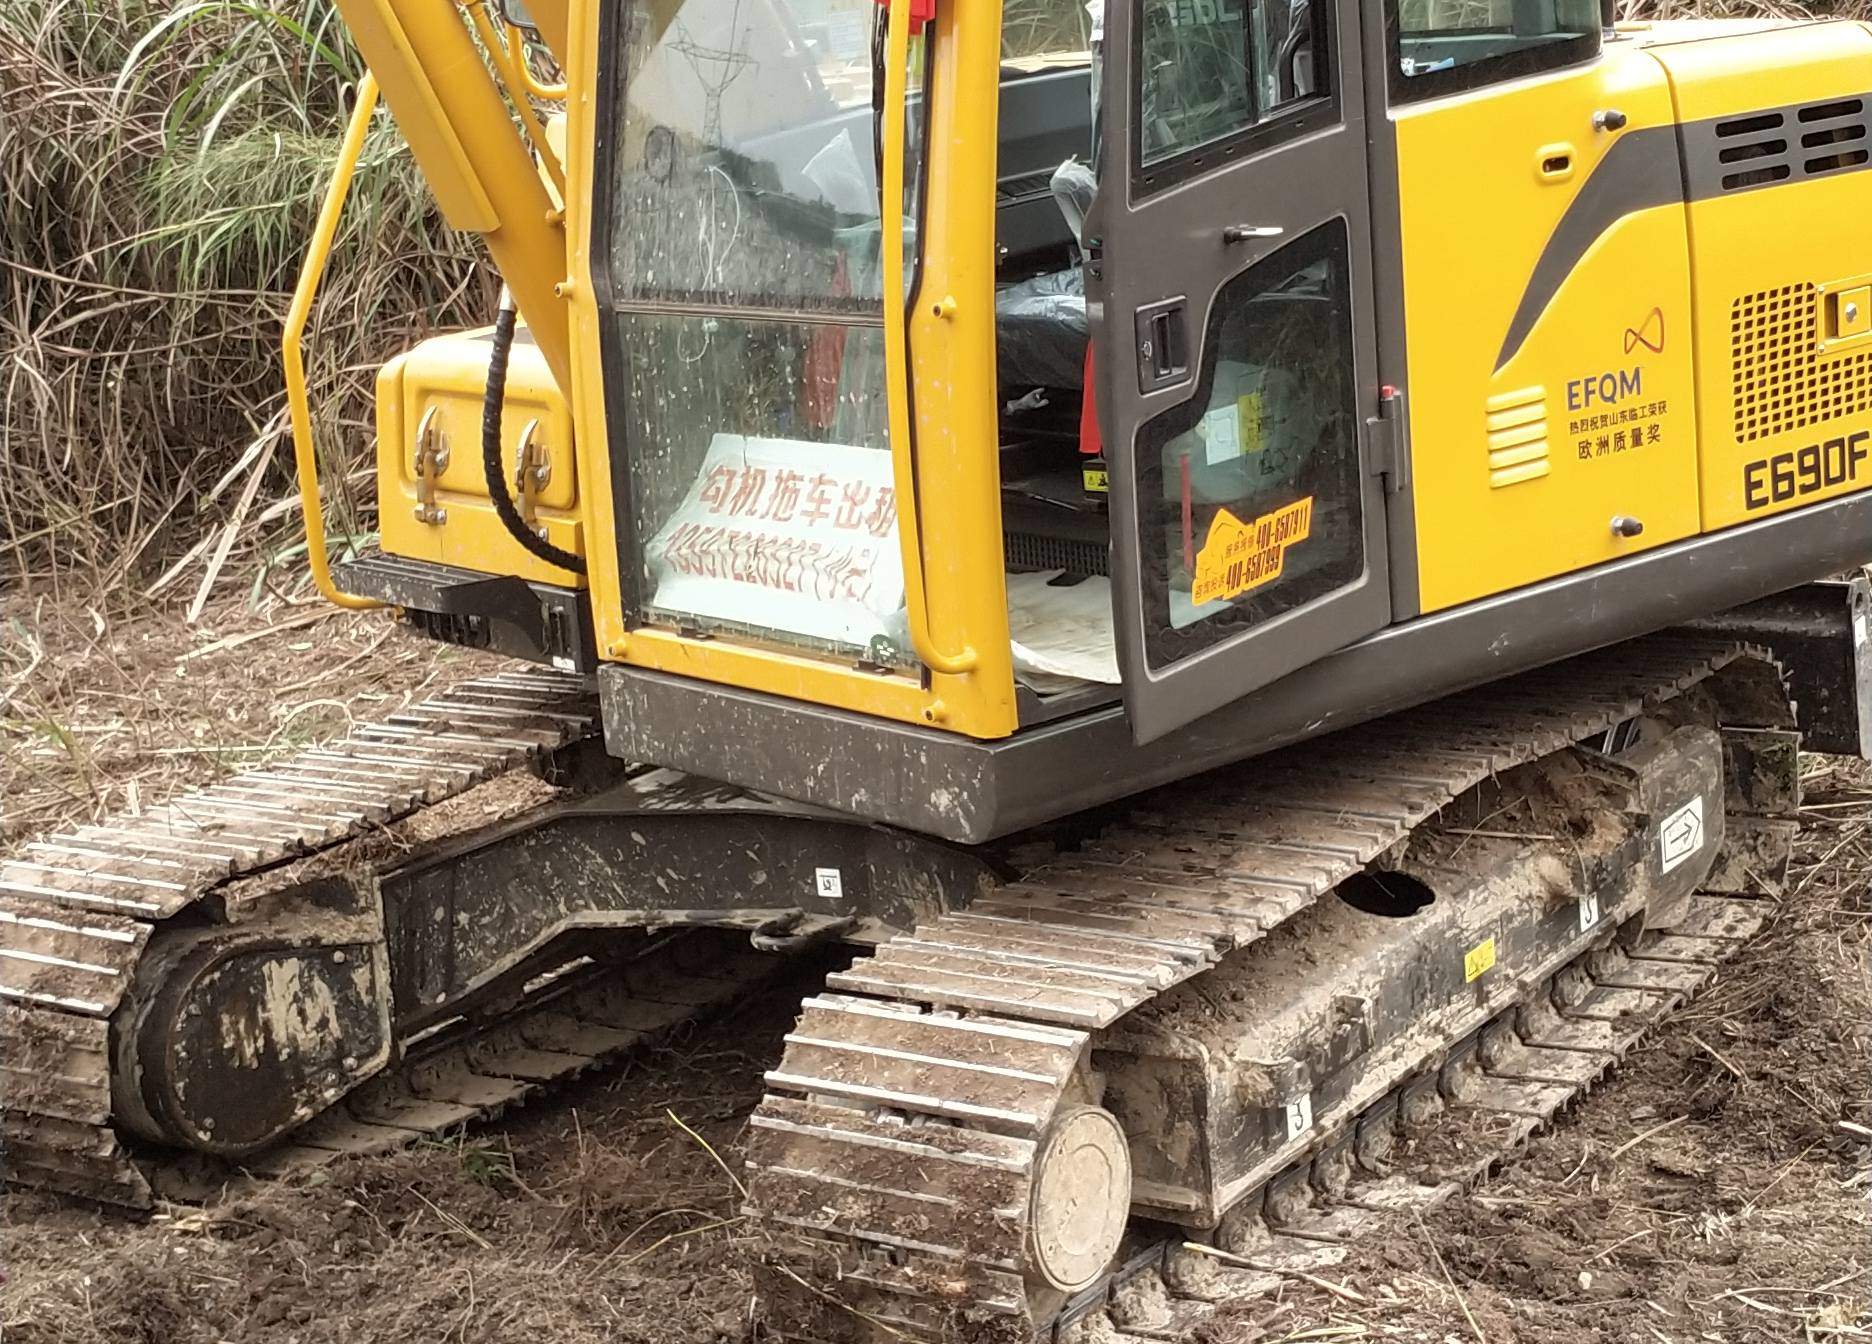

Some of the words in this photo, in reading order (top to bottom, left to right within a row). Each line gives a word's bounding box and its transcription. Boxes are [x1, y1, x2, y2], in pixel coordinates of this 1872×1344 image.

[1566, 366, 1642, 412] EFQM
[1569, 400, 1668, 435] 热烈祝贺山东临工荣获
[1578, 423, 1662, 460] 欧洲质量奖
[1743, 431, 1870, 511] E690F
